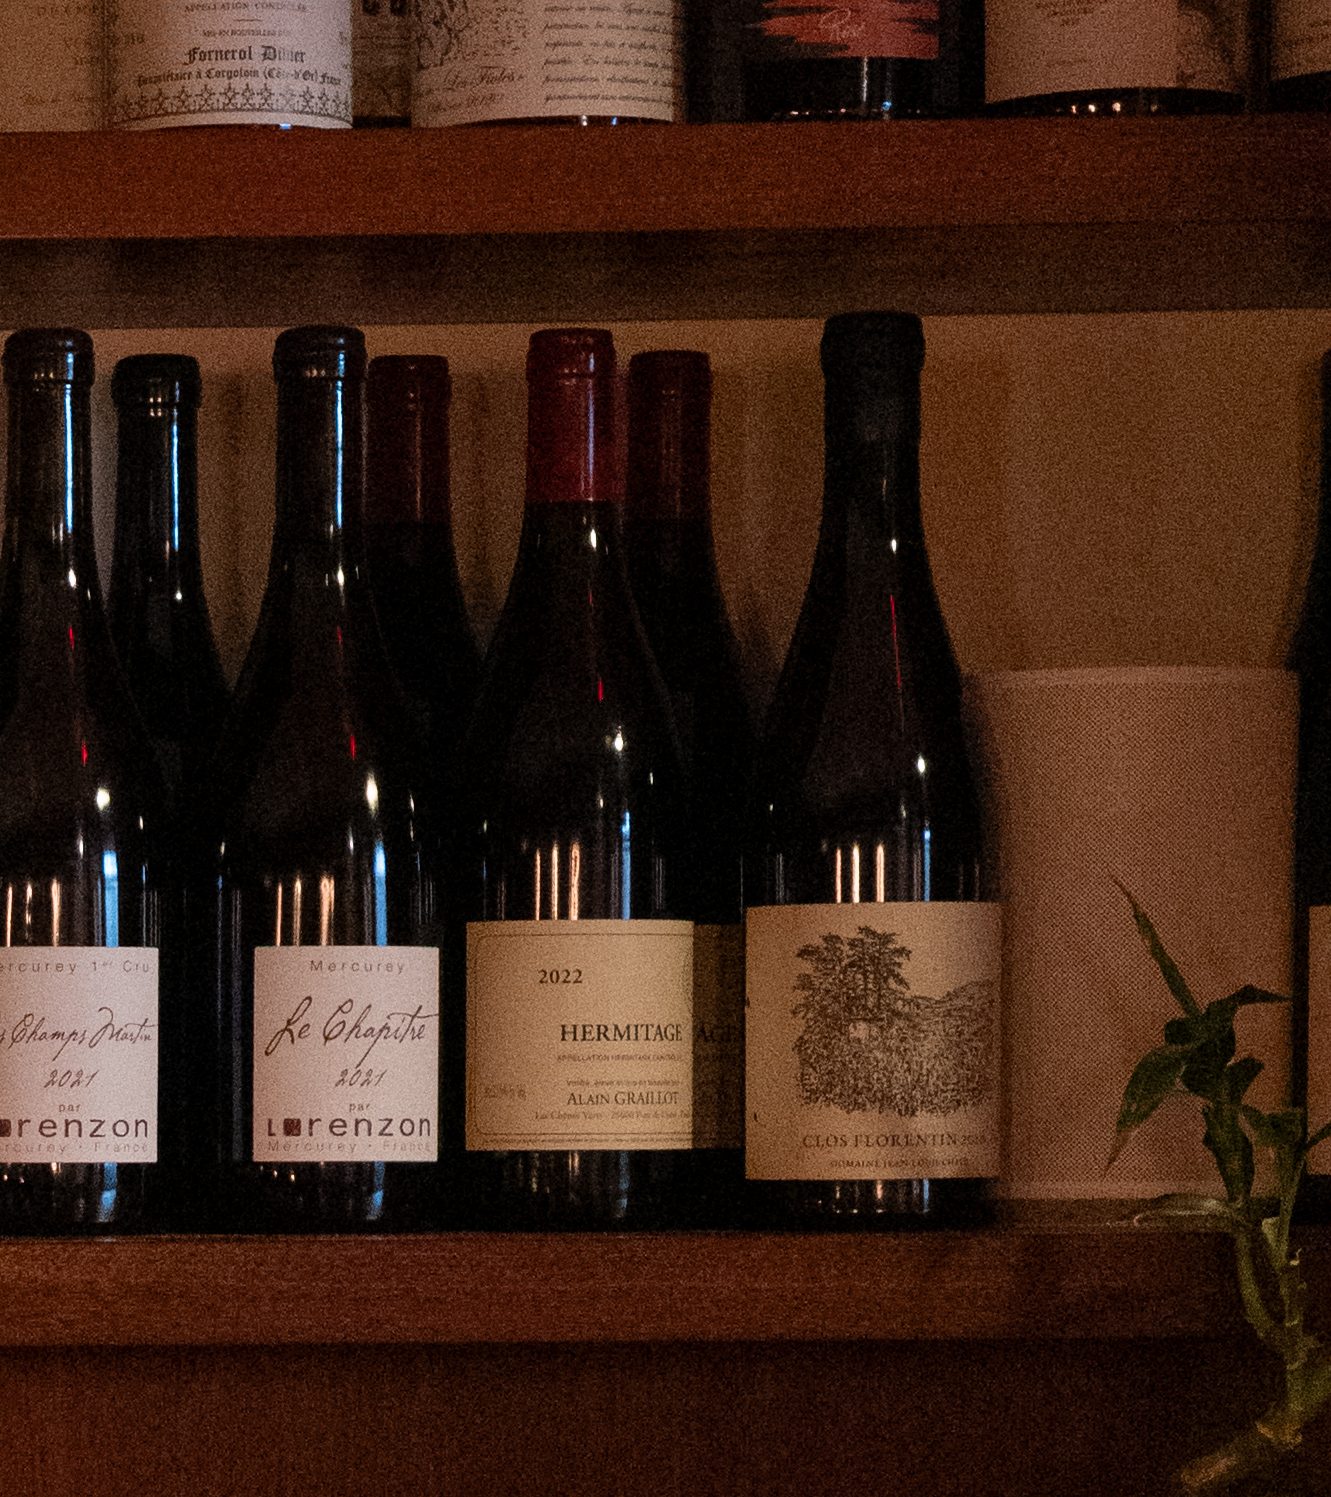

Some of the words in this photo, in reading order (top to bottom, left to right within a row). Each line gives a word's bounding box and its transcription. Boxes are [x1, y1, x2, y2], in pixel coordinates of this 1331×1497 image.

[123, 960, 150, 973] Cru
[310, 960, 404, 974] Mercurey
[538, 969, 583, 985] 2022
[8, 1013, 87, 1062] Champs
[264, 996, 312, 1056] Le
[323, 999, 439, 1069] Chapitre
[561, 1024, 683, 1042] HERMITAGE
[44, 1069, 99, 1088] 2021
[335, 1069, 387, 1088] 2021
[58, 1103, 81, 1114] par
[349, 1104, 370, 1113] par
[802, 1134, 847, 1148] CLOS
[854, 1134, 957, 1147] FLORENTIN
